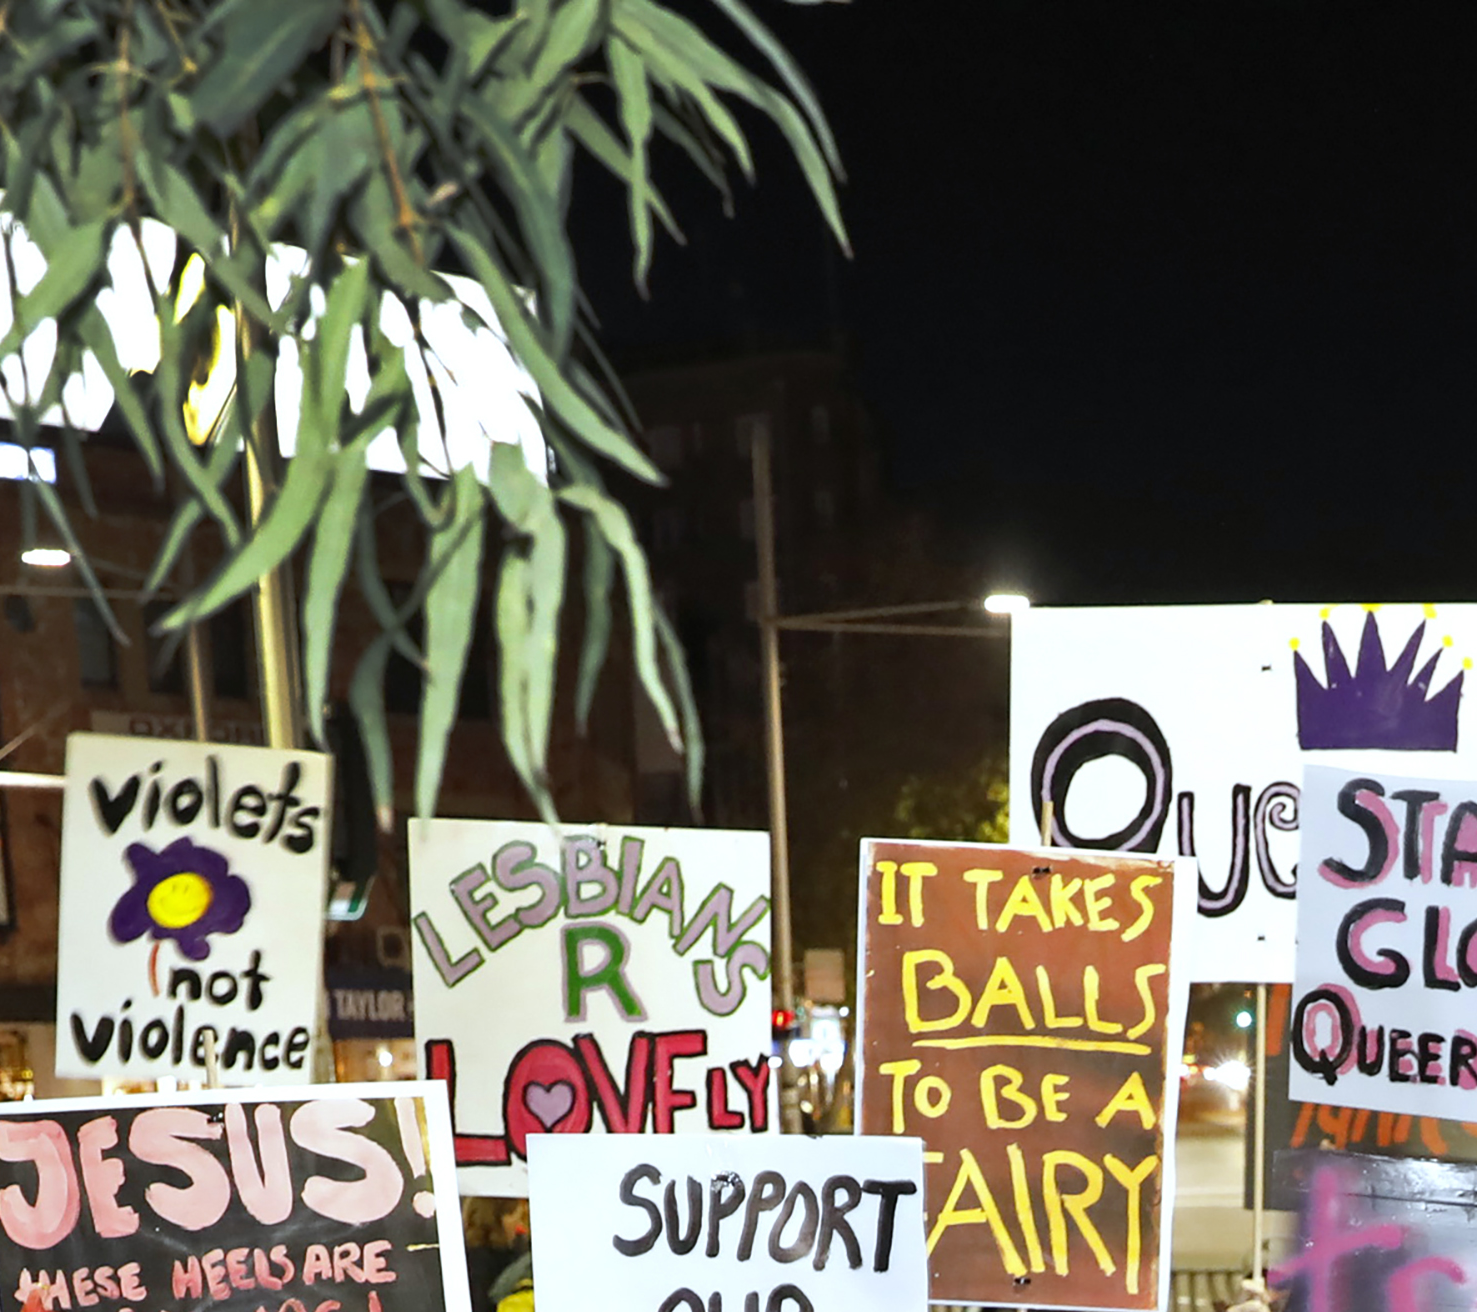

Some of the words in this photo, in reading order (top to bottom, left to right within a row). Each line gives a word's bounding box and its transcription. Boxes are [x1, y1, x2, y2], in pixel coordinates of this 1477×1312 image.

[414, 834, 772, 1016] LESBIANS
[876, 861, 938, 927] IT
[963, 868, 1164, 942] TAKES
[167, 950, 271, 1008] not
[562, 923, 651, 1024] R
[902, 949, 1167, 1041] BALLS
[70, 1005, 311, 1072] violence
[423, 1030, 772, 1168] LOVELY
[879, 1059, 953, 1133] TO
[980, 1064, 1071, 1129] BE
[1096, 1072, 1156, 1129] A
[613, 1163, 916, 1272] SUPPORT
[924, 1142, 1160, 1295] AIRY
[172, 1243, 296, 1300] HEELS
[302, 1239, 397, 1285] ARE
